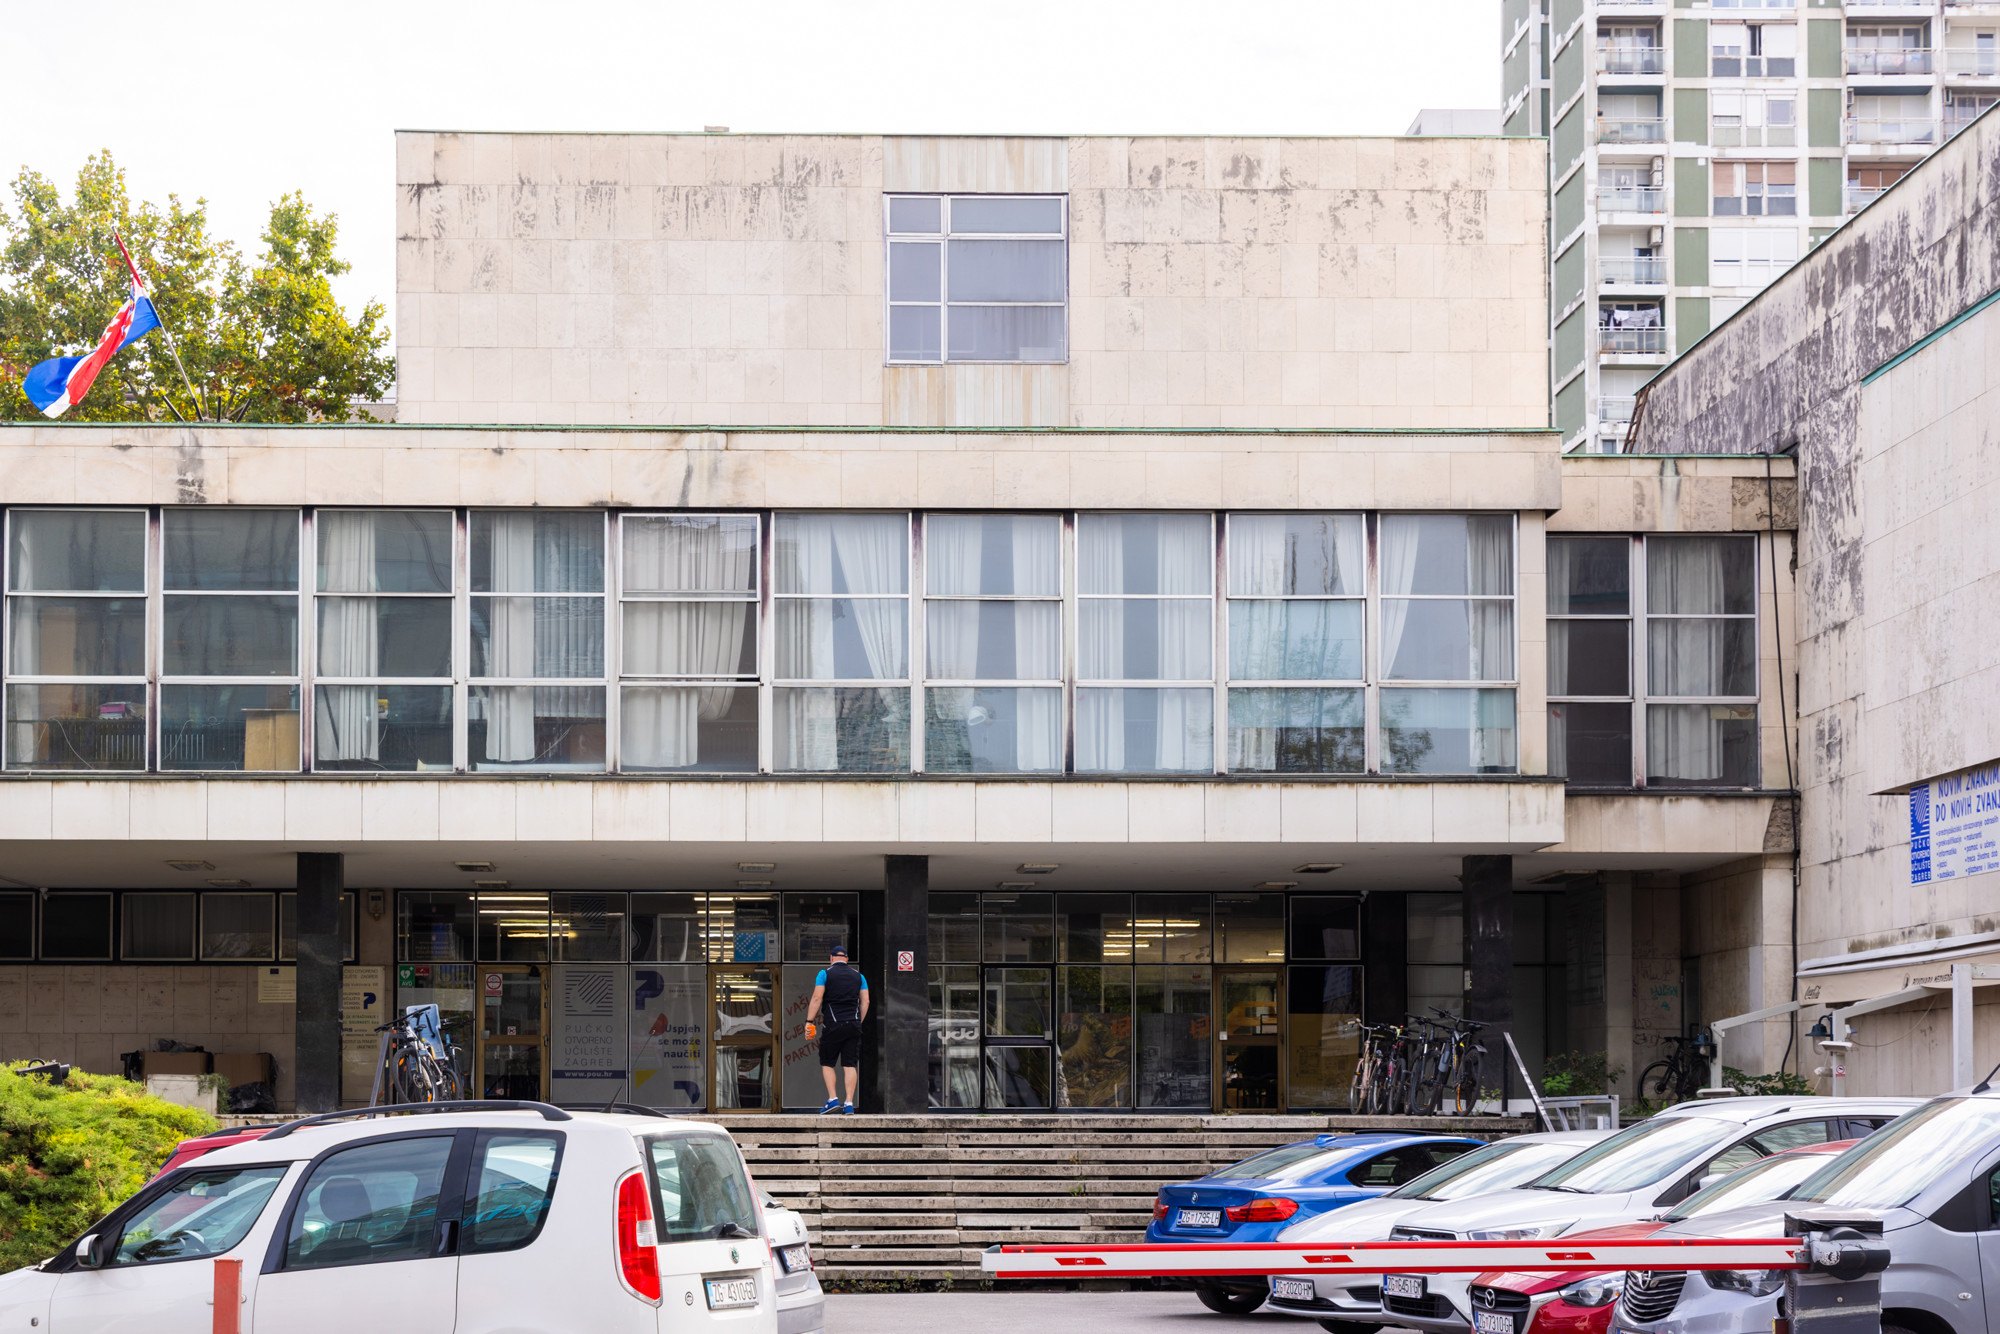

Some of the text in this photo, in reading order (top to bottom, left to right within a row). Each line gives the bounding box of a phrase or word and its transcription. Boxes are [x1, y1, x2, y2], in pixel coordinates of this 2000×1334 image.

[1938, 765, 2000, 798] NOVIM ZNANJIM
[1936, 789, 2000, 822] DO NOVIH ZVANJ
[1911, 838, 1930, 850] PUČKO
[1911, 849, 1930, 860] OTVORENO
[1912, 860, 1930, 871] UČILIŠTE
[1911, 871, 1931, 882] ZAGREB
[565, 1024, 613, 1033] PUČKO
[664, 1024, 700, 1035] Uspjeh
[565, 1036, 613, 1044] OTVORENO
[672, 1036, 700, 1045] može
[565, 1046, 613, 1056] UČILIŠTE
[664, 1049, 700, 1058] naučiti
[784, 1040, 820, 1066] PARTN
[1182, 1212, 1219, 1224] ZG 1795-LH
[1276, 1280, 1313, 1296] ZG 2020-HM
[1387, 1277, 1422, 1294] ZG 6451-GM
[712, 1282, 757, 1302] ZG 4310-GD
[1479, 1313, 1513, 1332] ZG 7310-GH
